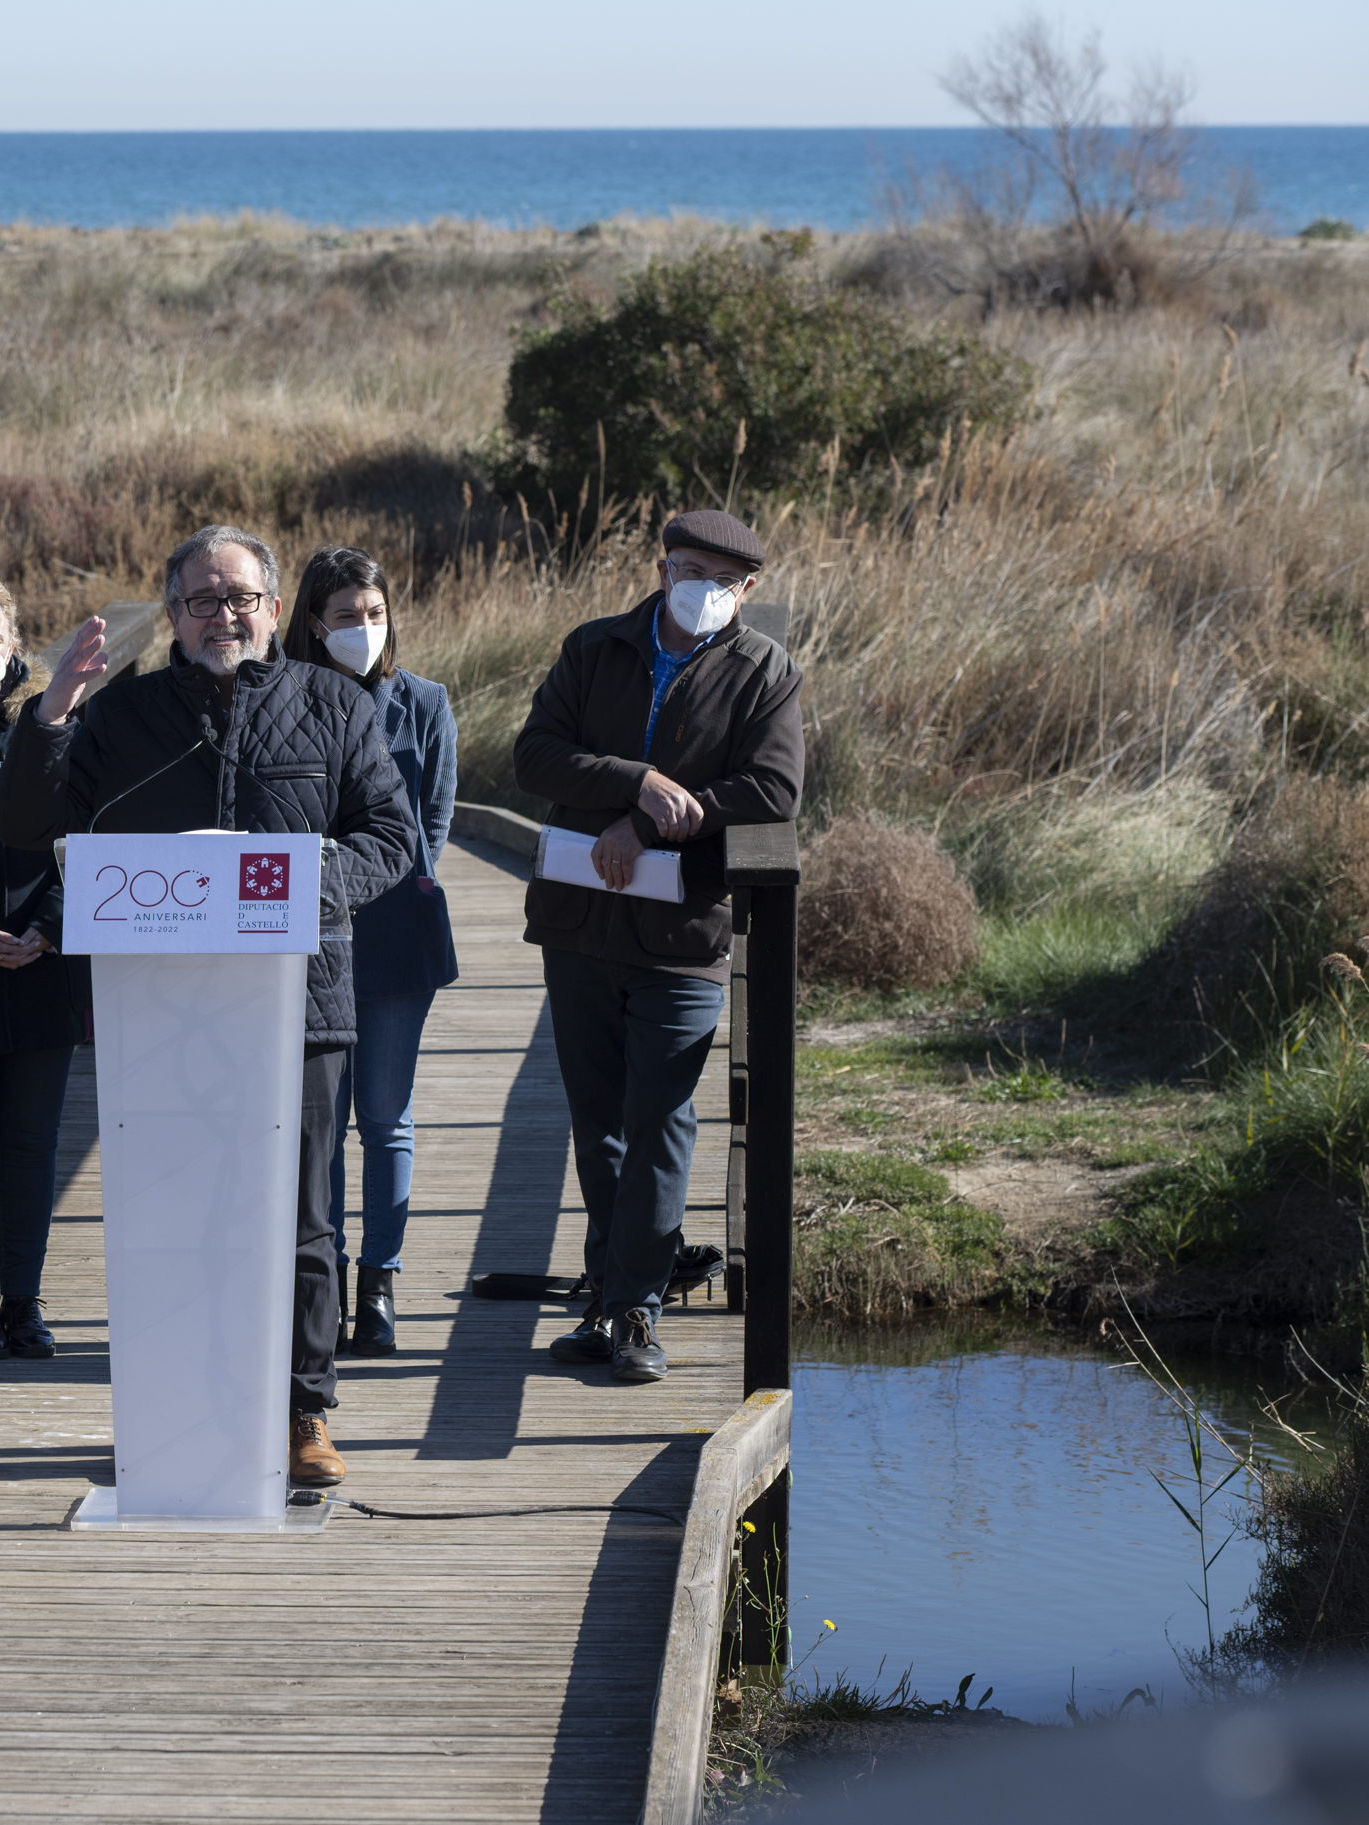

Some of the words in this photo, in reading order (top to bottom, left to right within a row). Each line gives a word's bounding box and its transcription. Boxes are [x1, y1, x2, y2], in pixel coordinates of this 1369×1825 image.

[238, 902, 289, 911] DIPUTACIÓ
[134, 913, 207, 921] ANIVERSARI
[237, 920, 289, 929] CASTELLÓ
